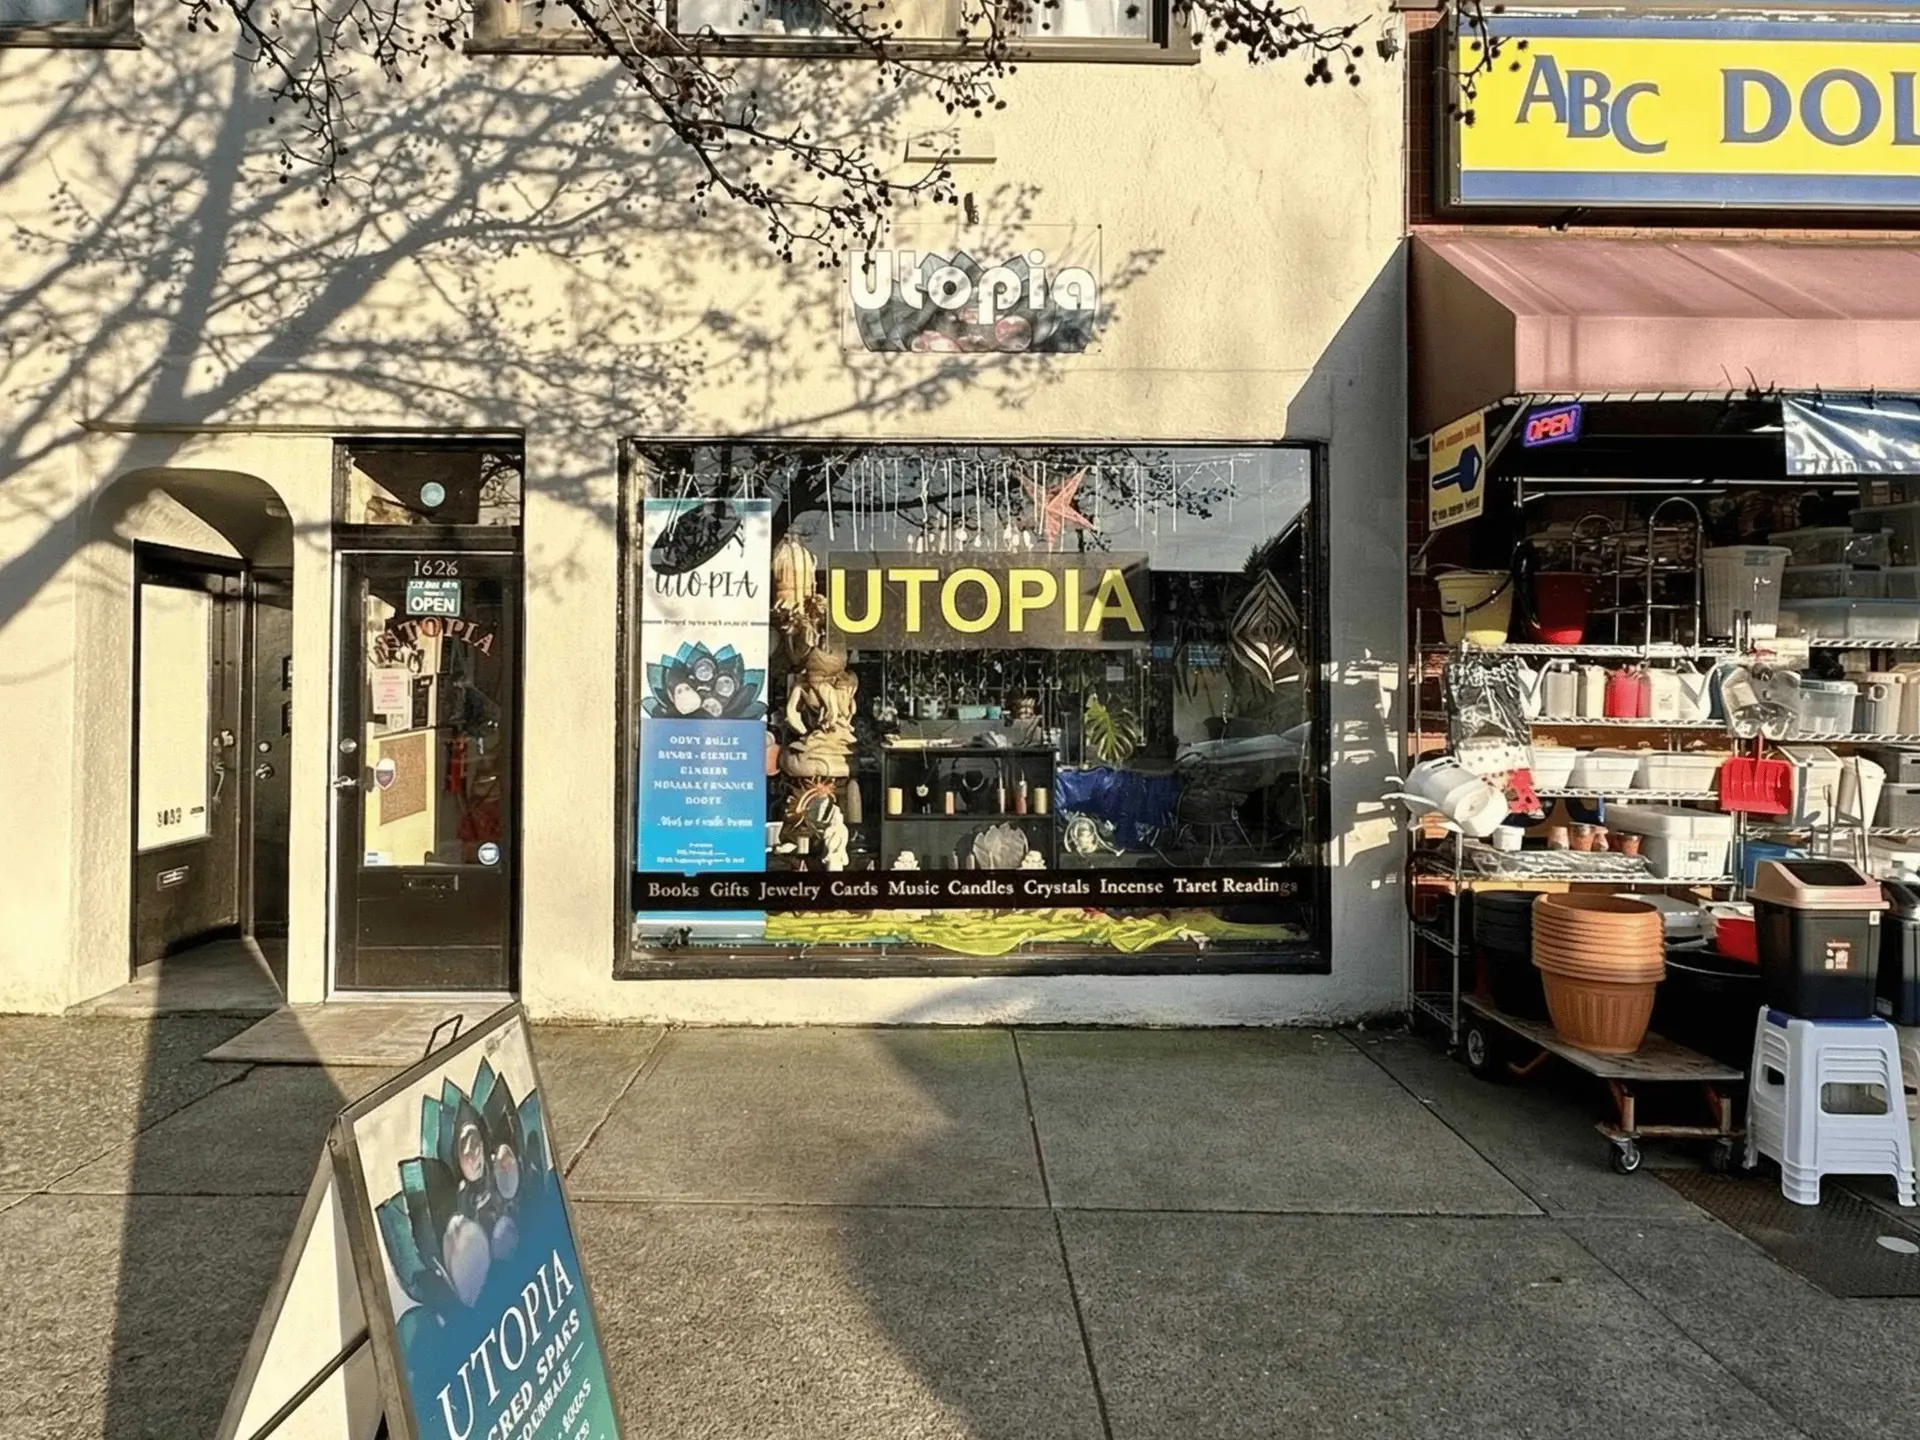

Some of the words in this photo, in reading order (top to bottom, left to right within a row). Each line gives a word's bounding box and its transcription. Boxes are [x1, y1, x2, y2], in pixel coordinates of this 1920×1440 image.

[1515, 54, 1667, 154] ABC
[848, 249, 1097, 325] Utopia
[1527, 409, 1578, 442] OPEN
[413, 559, 459, 577] 1626
[411, 596, 456, 613] OPEN
[831, 568, 1145, 633] UTOPIA
[648, 882, 700, 897] Books
[710, 881, 750, 897] Gifts
[758, 882, 821, 901] Jewelry
[830, 880, 879, 896] Cards
[888, 880, 939, 896] Music
[948, 880, 1014, 895] Candles
[1023, 879, 1090, 898] Crystals
[1100, 878, 1164, 894] Incense
[1222, 877, 1298, 896] Readings
[436, 1249, 574, 1440] UTOPIA
